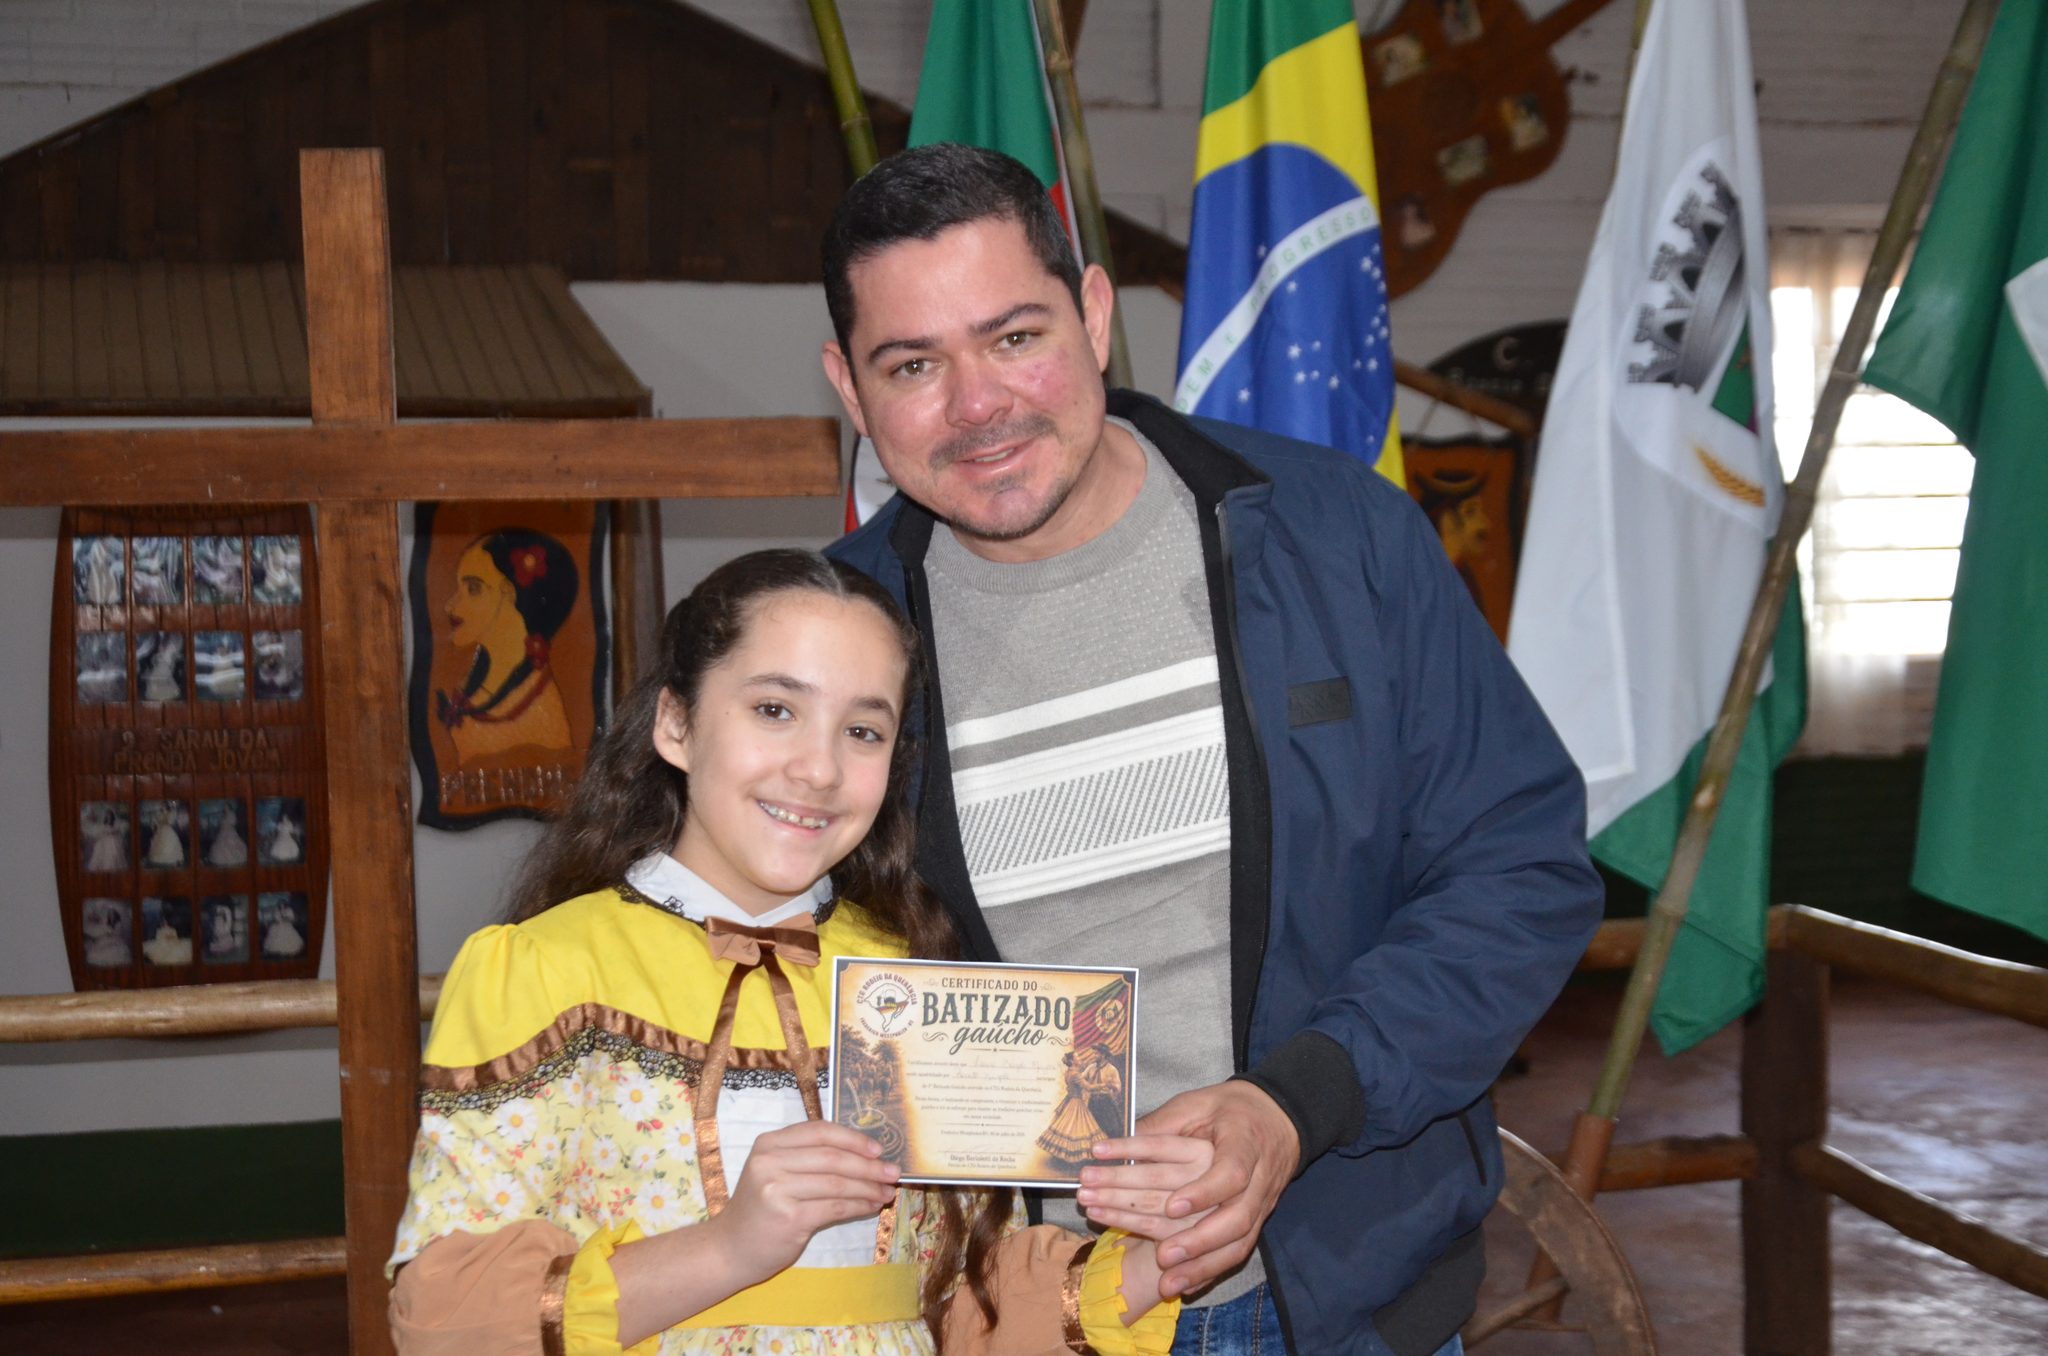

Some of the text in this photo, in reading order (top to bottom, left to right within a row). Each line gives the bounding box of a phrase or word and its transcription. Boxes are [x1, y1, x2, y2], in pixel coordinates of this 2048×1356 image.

[1176, 358, 1214, 411] DEM
[941, 977, 1038, 991] CERTIFICADO DO
[921, 992, 1071, 1031] BATIZADO
[949, 1014, 1048, 1056] gaúcho
